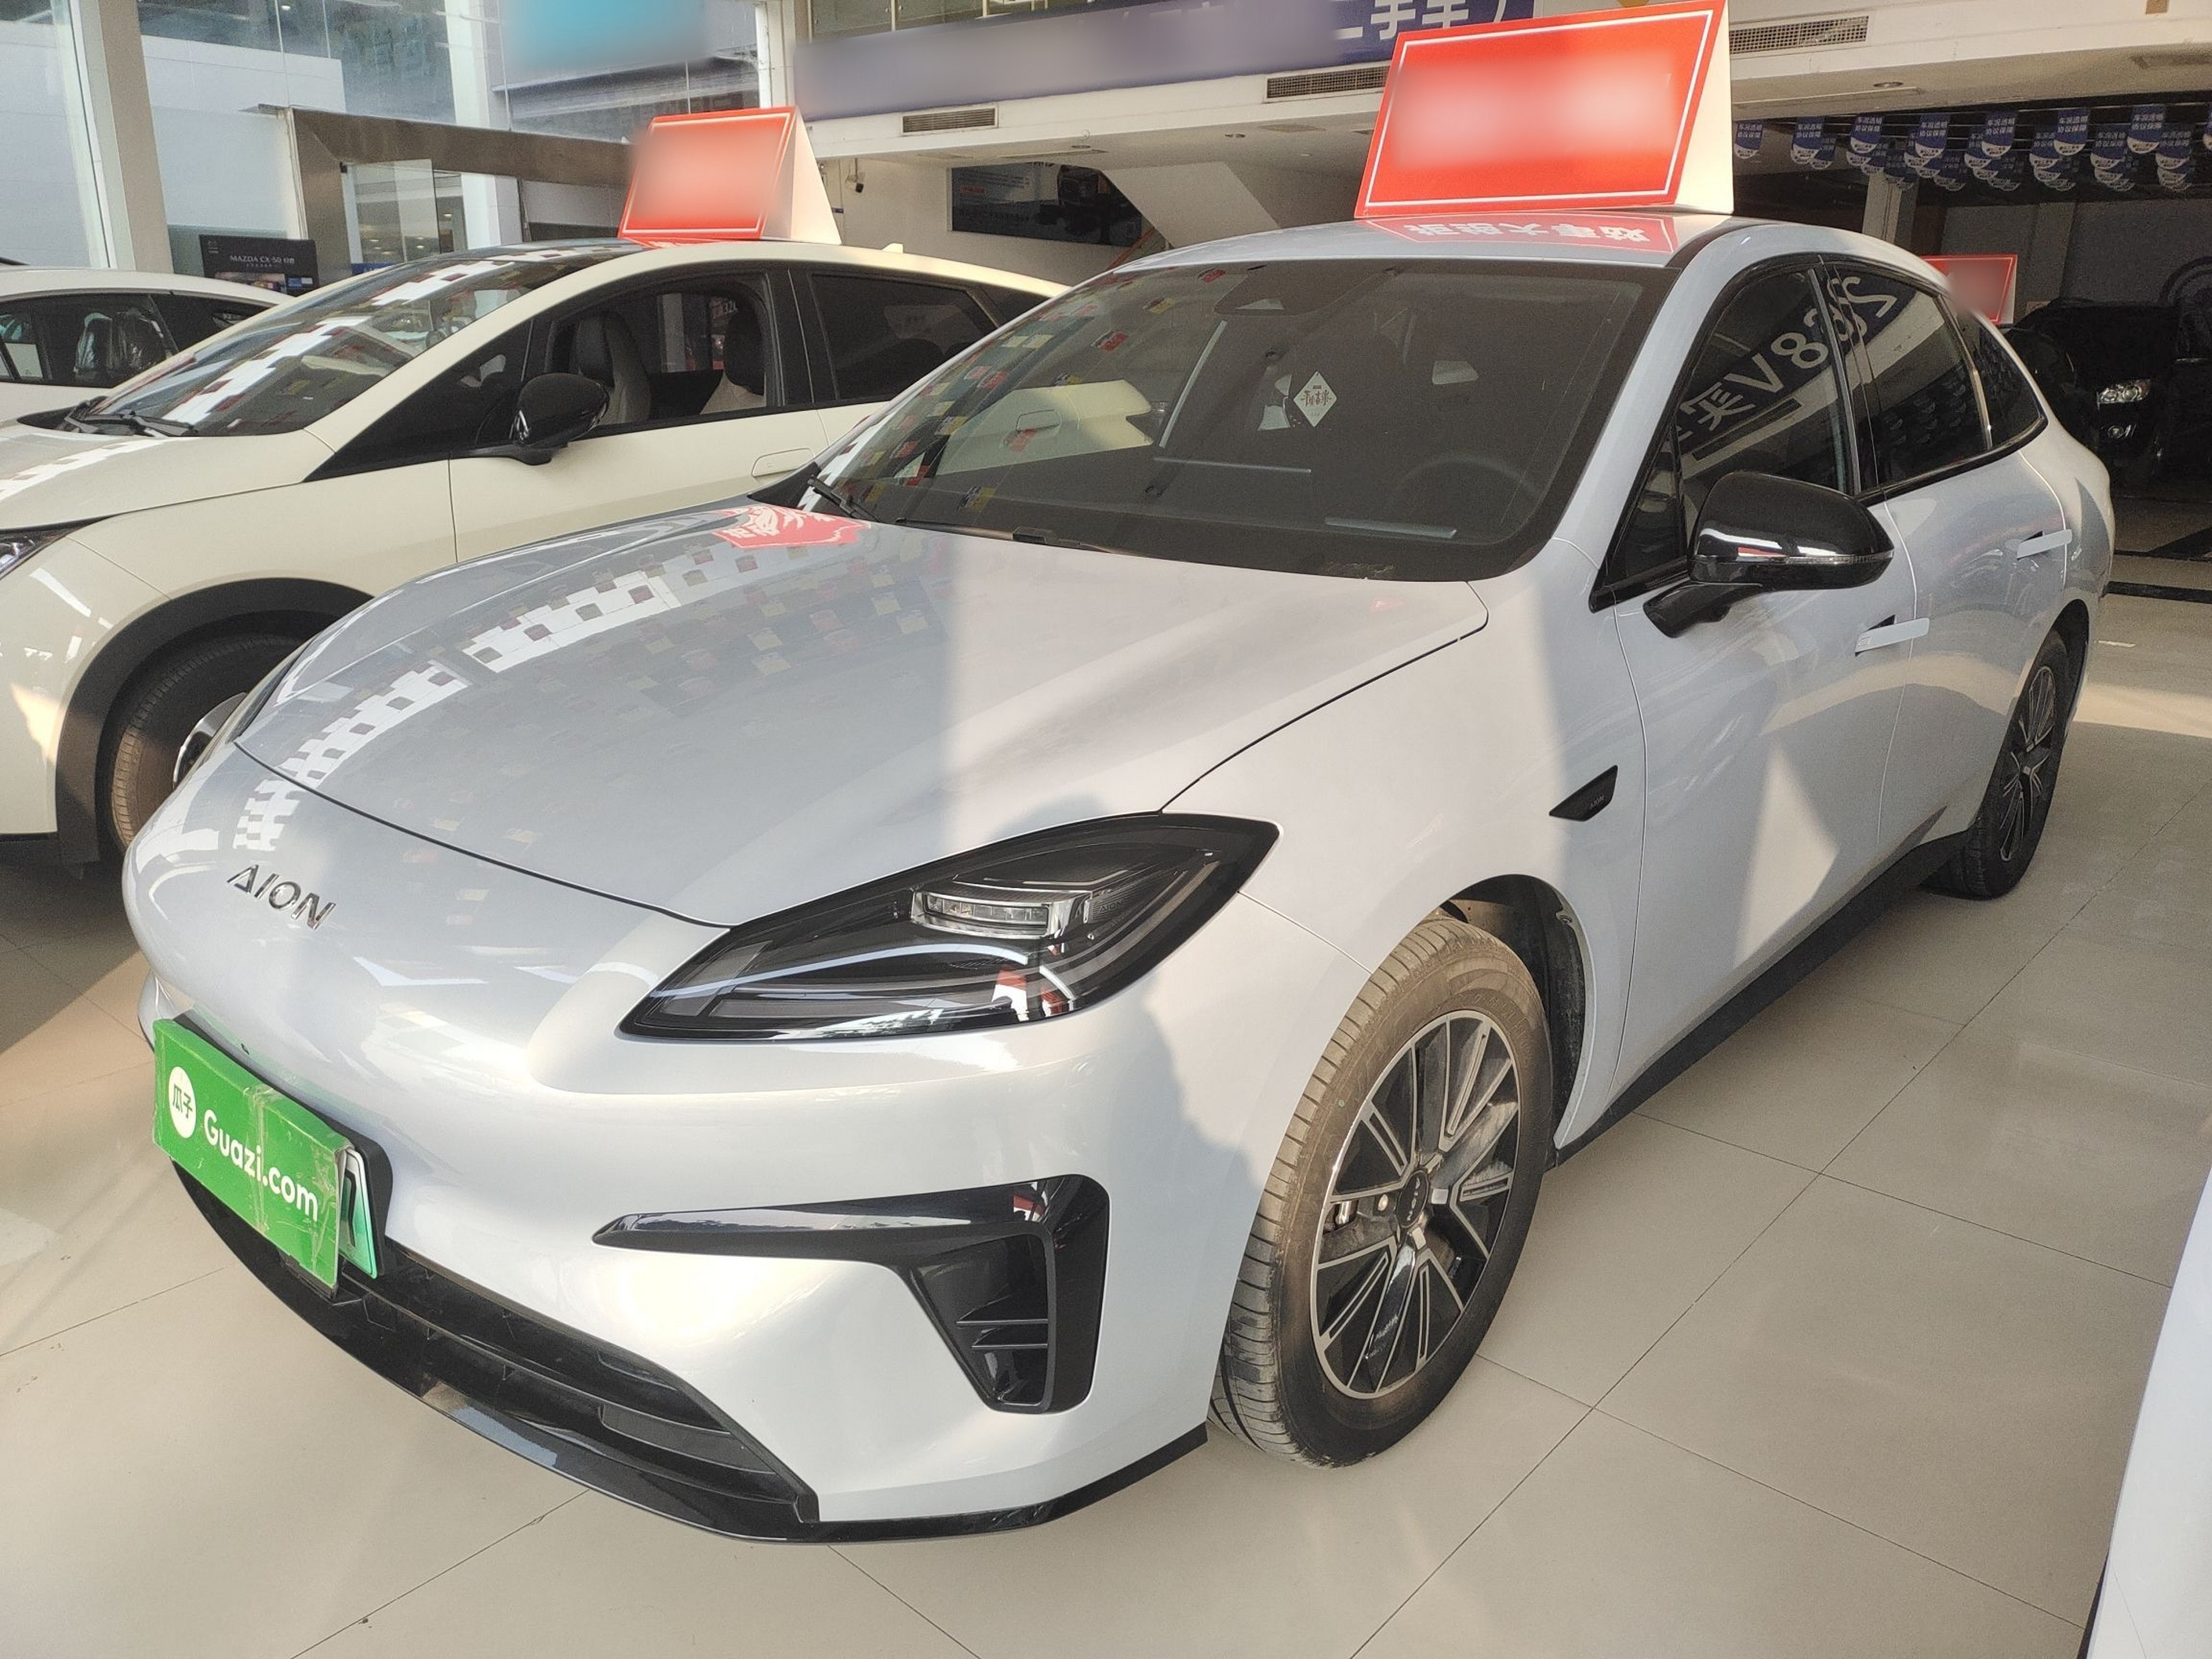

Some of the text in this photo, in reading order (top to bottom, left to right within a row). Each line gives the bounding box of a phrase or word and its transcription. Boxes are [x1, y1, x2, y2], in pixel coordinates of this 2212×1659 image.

[230, 254, 259, 262] MAZDA
[226, 864, 336, 930] AION
[1099, 899, 1123, 913] AION
[172, 1083, 193, 1119] 瓜子
[204, 1109, 319, 1222] Guazi.com
